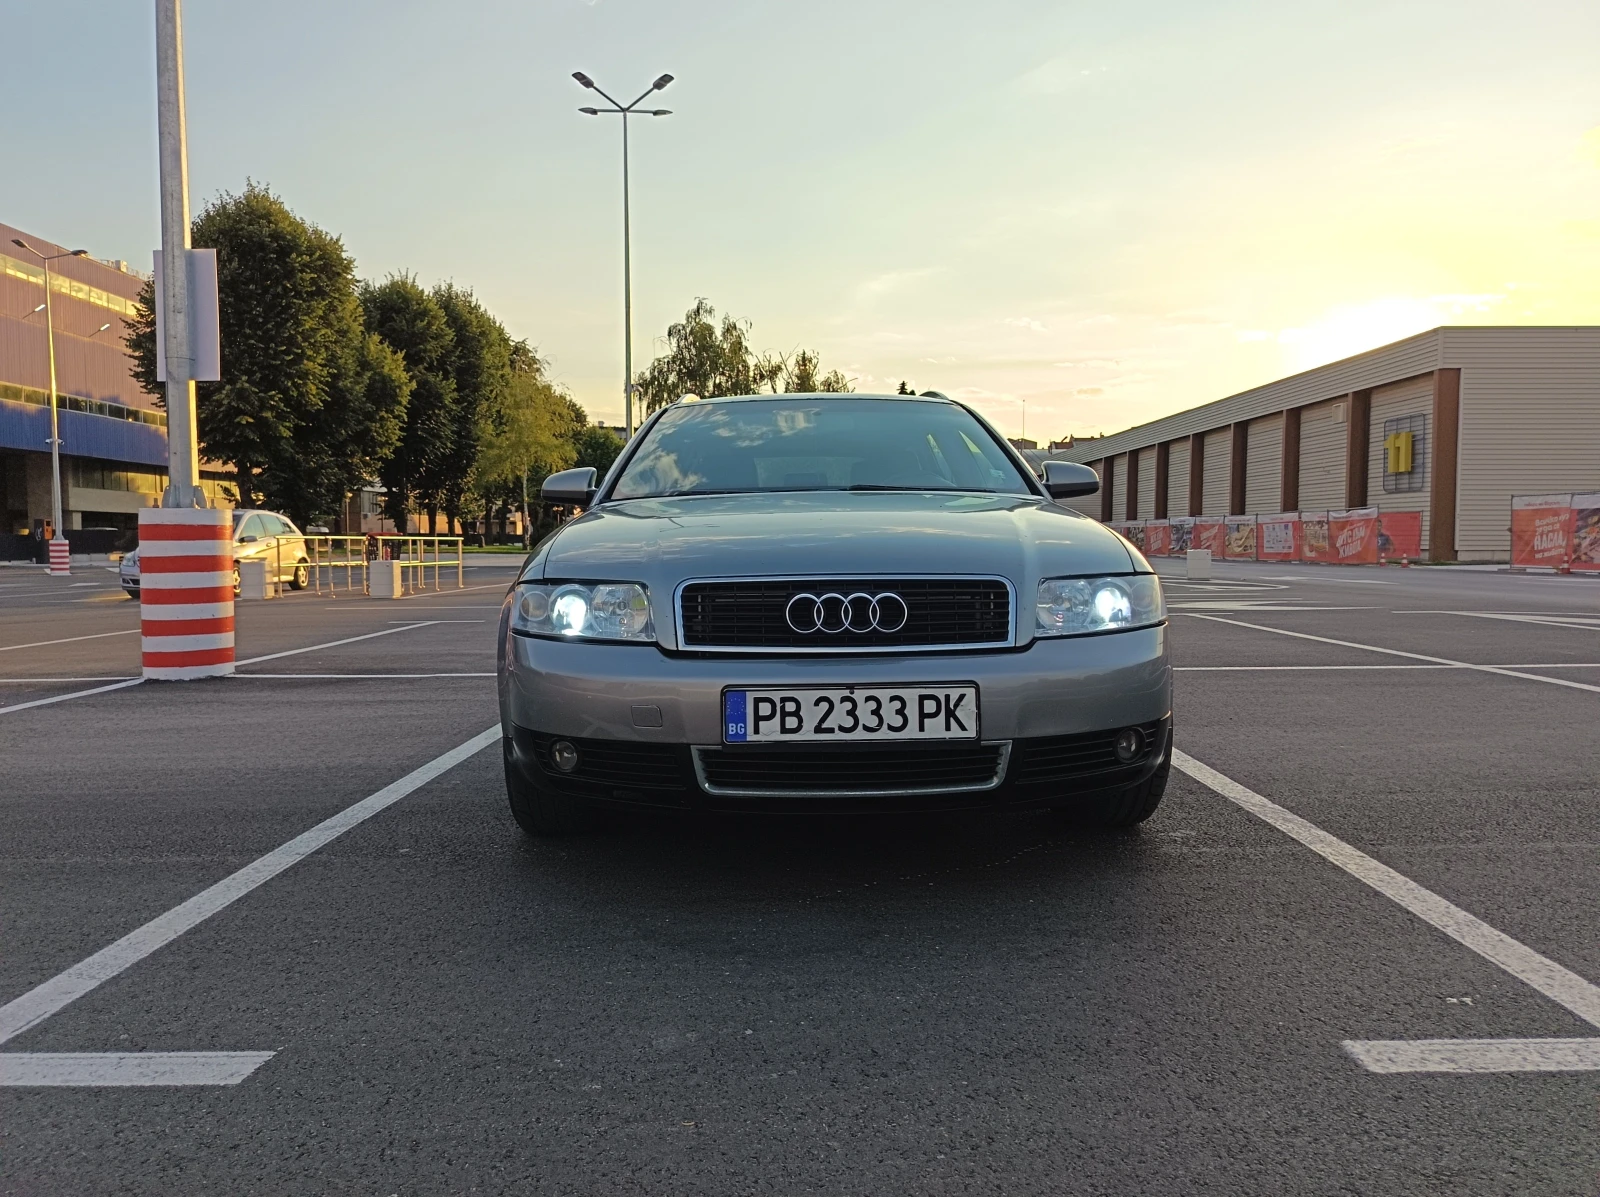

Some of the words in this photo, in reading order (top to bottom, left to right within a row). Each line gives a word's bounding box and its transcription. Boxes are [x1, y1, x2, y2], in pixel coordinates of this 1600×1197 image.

[1384, 432, 1413, 473] 11
[728, 723, 745, 735] BG
[753, 696, 804, 735] PB
[813, 695, 909, 734] 2333
[918, 693, 968, 733] PK
